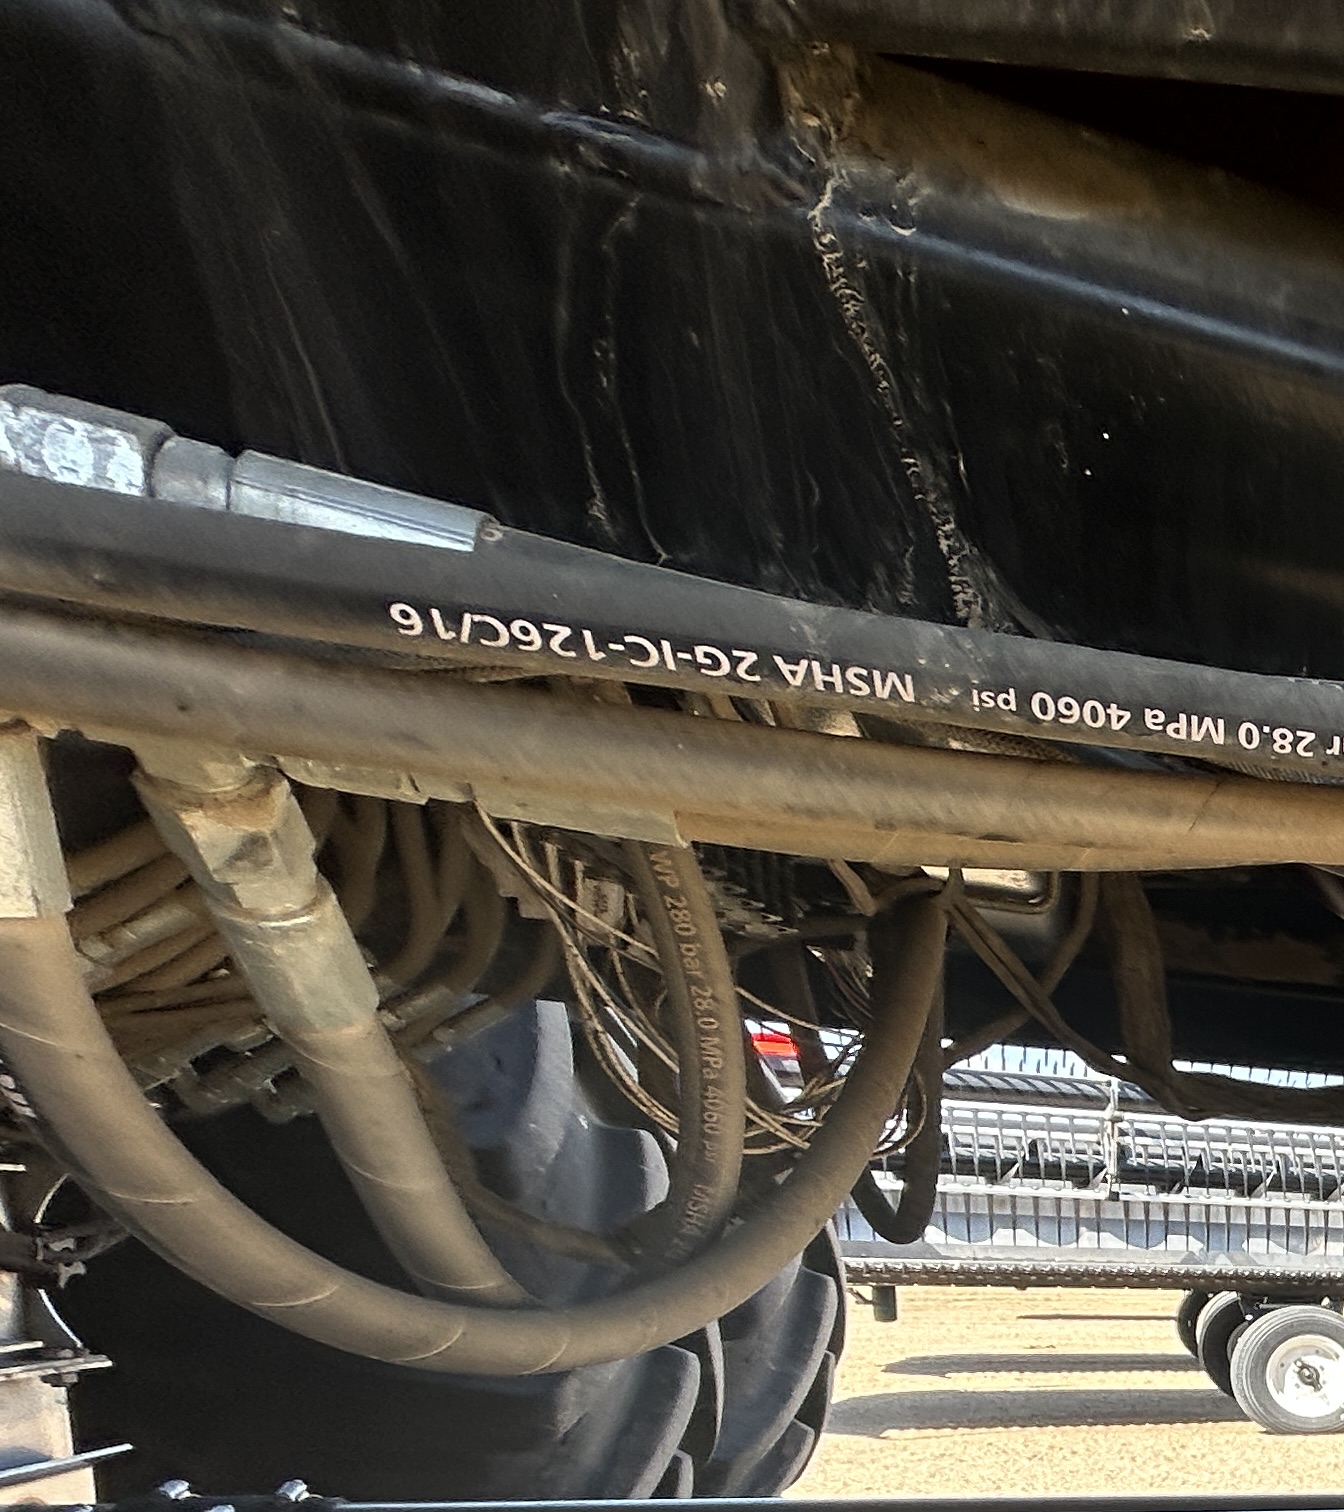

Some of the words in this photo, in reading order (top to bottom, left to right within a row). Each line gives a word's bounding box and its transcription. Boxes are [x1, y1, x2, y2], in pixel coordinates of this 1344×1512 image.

[388, 601, 762, 683] 2G-IC-126C/16
[772, 653, 916, 703] MSHA
[971, 687, 1018, 713] psi
[1031, 691, 1132, 732] 4060
[1143, 708, 1226, 746] MPa
[1237, 721, 1317, 758] 28.0
[663, 895, 698, 937] 280
[678, 943, 703, 976] bar
[690, 984, 721, 1030] 28.0
[700, 1036, 724, 1080] MPa
[702, 1084, 725, 1135] 4060
